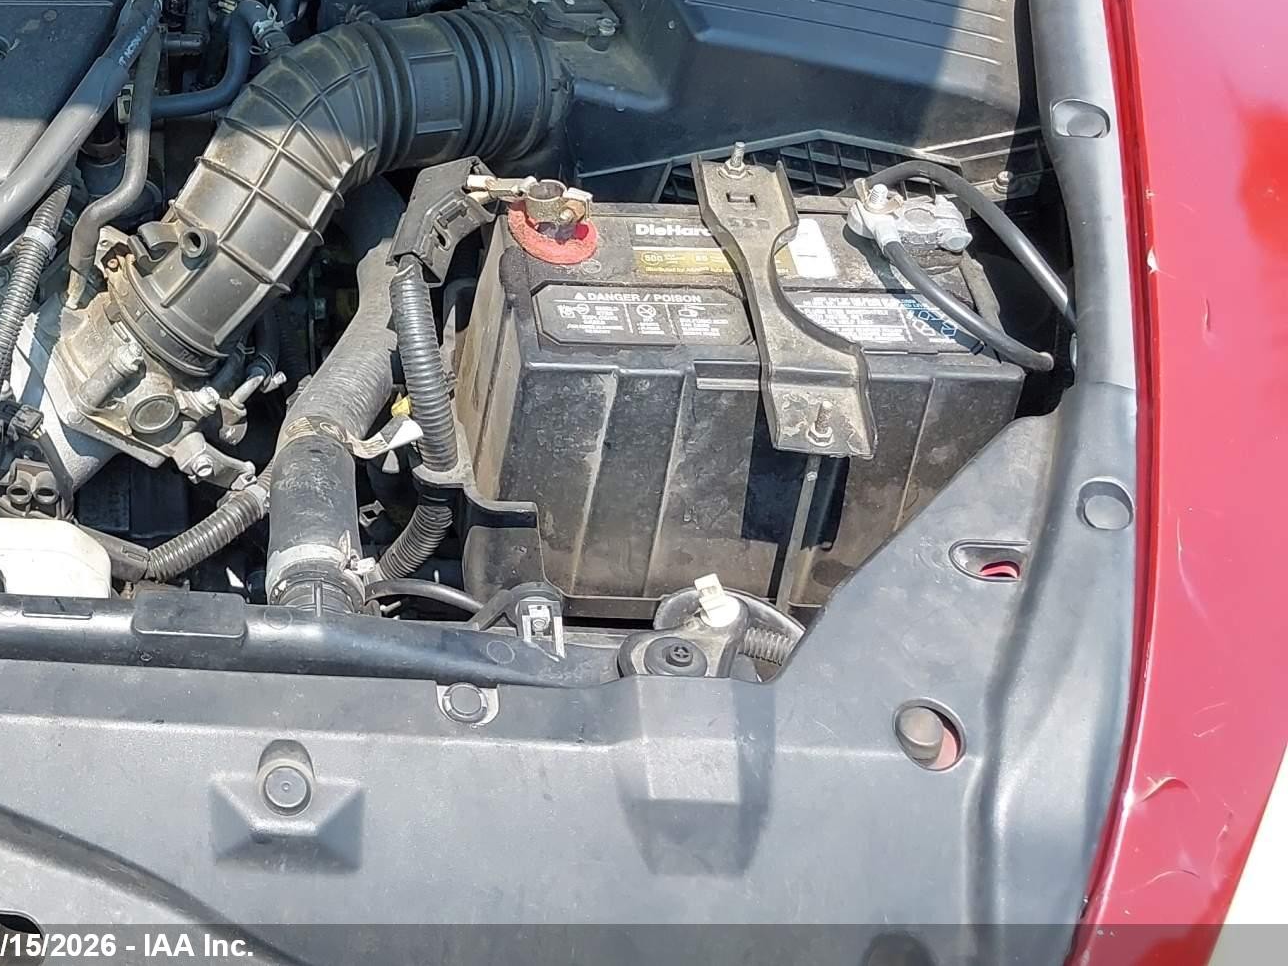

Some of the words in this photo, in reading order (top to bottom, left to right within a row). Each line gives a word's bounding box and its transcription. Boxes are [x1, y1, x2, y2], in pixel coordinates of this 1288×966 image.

[587, 292, 641, 302] DANGER
[642, 293, 649, 302] /
[653, 294, 702, 303] POISON
